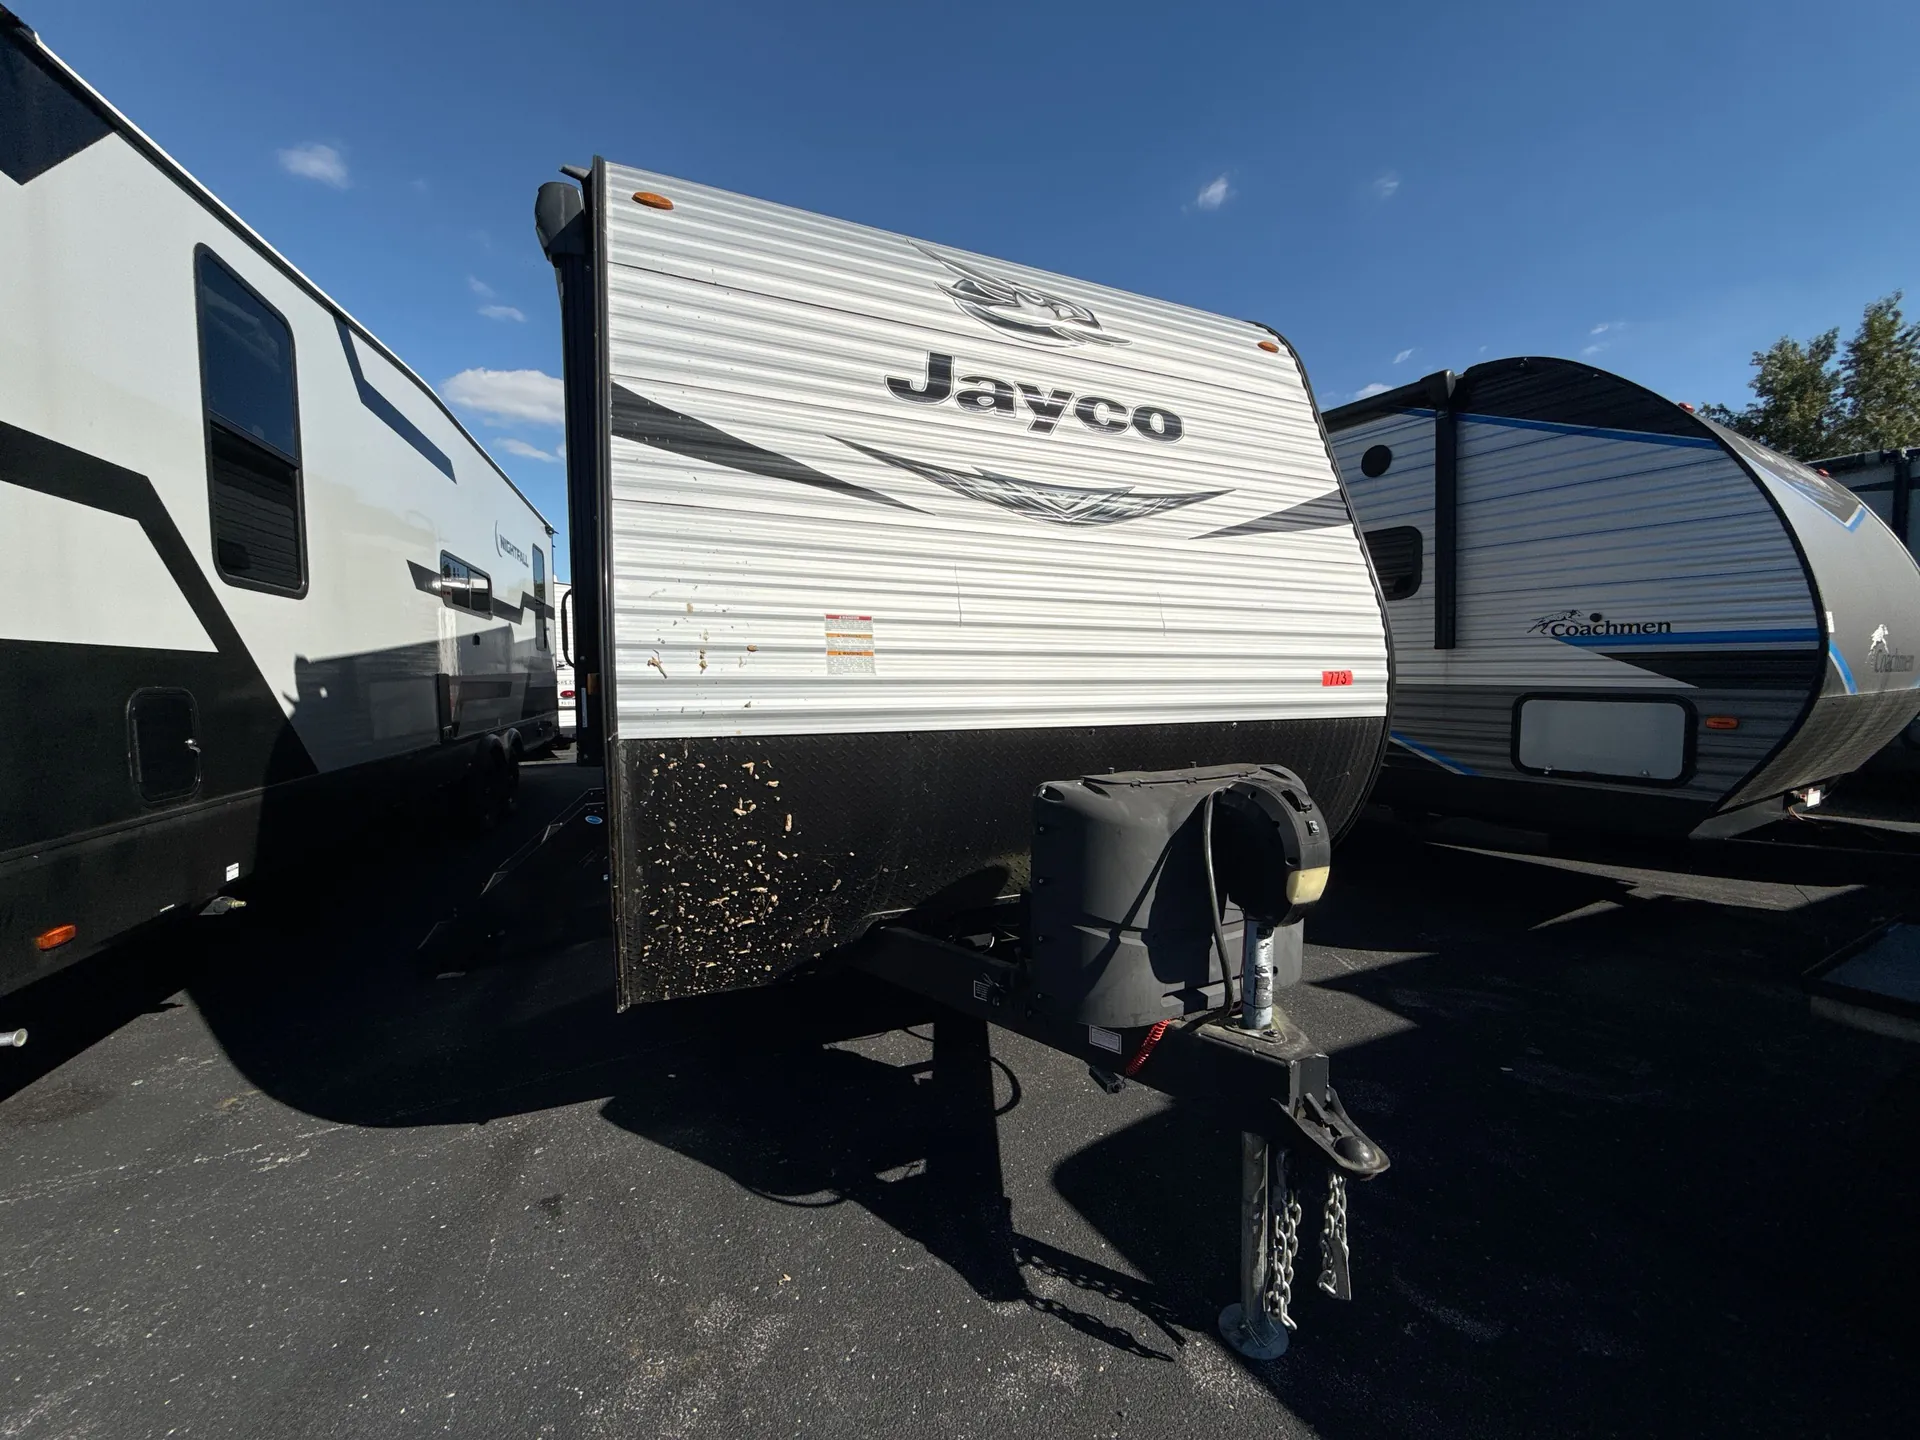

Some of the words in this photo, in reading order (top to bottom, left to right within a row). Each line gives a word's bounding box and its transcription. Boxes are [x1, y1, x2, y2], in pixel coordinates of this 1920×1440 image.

[884, 350, 1185, 443] Jayco
[499, 534, 529, 568] NIGHTFALL
[1551, 620, 1672, 637] Coachmen
[1328, 671, 1347, 685] 773
